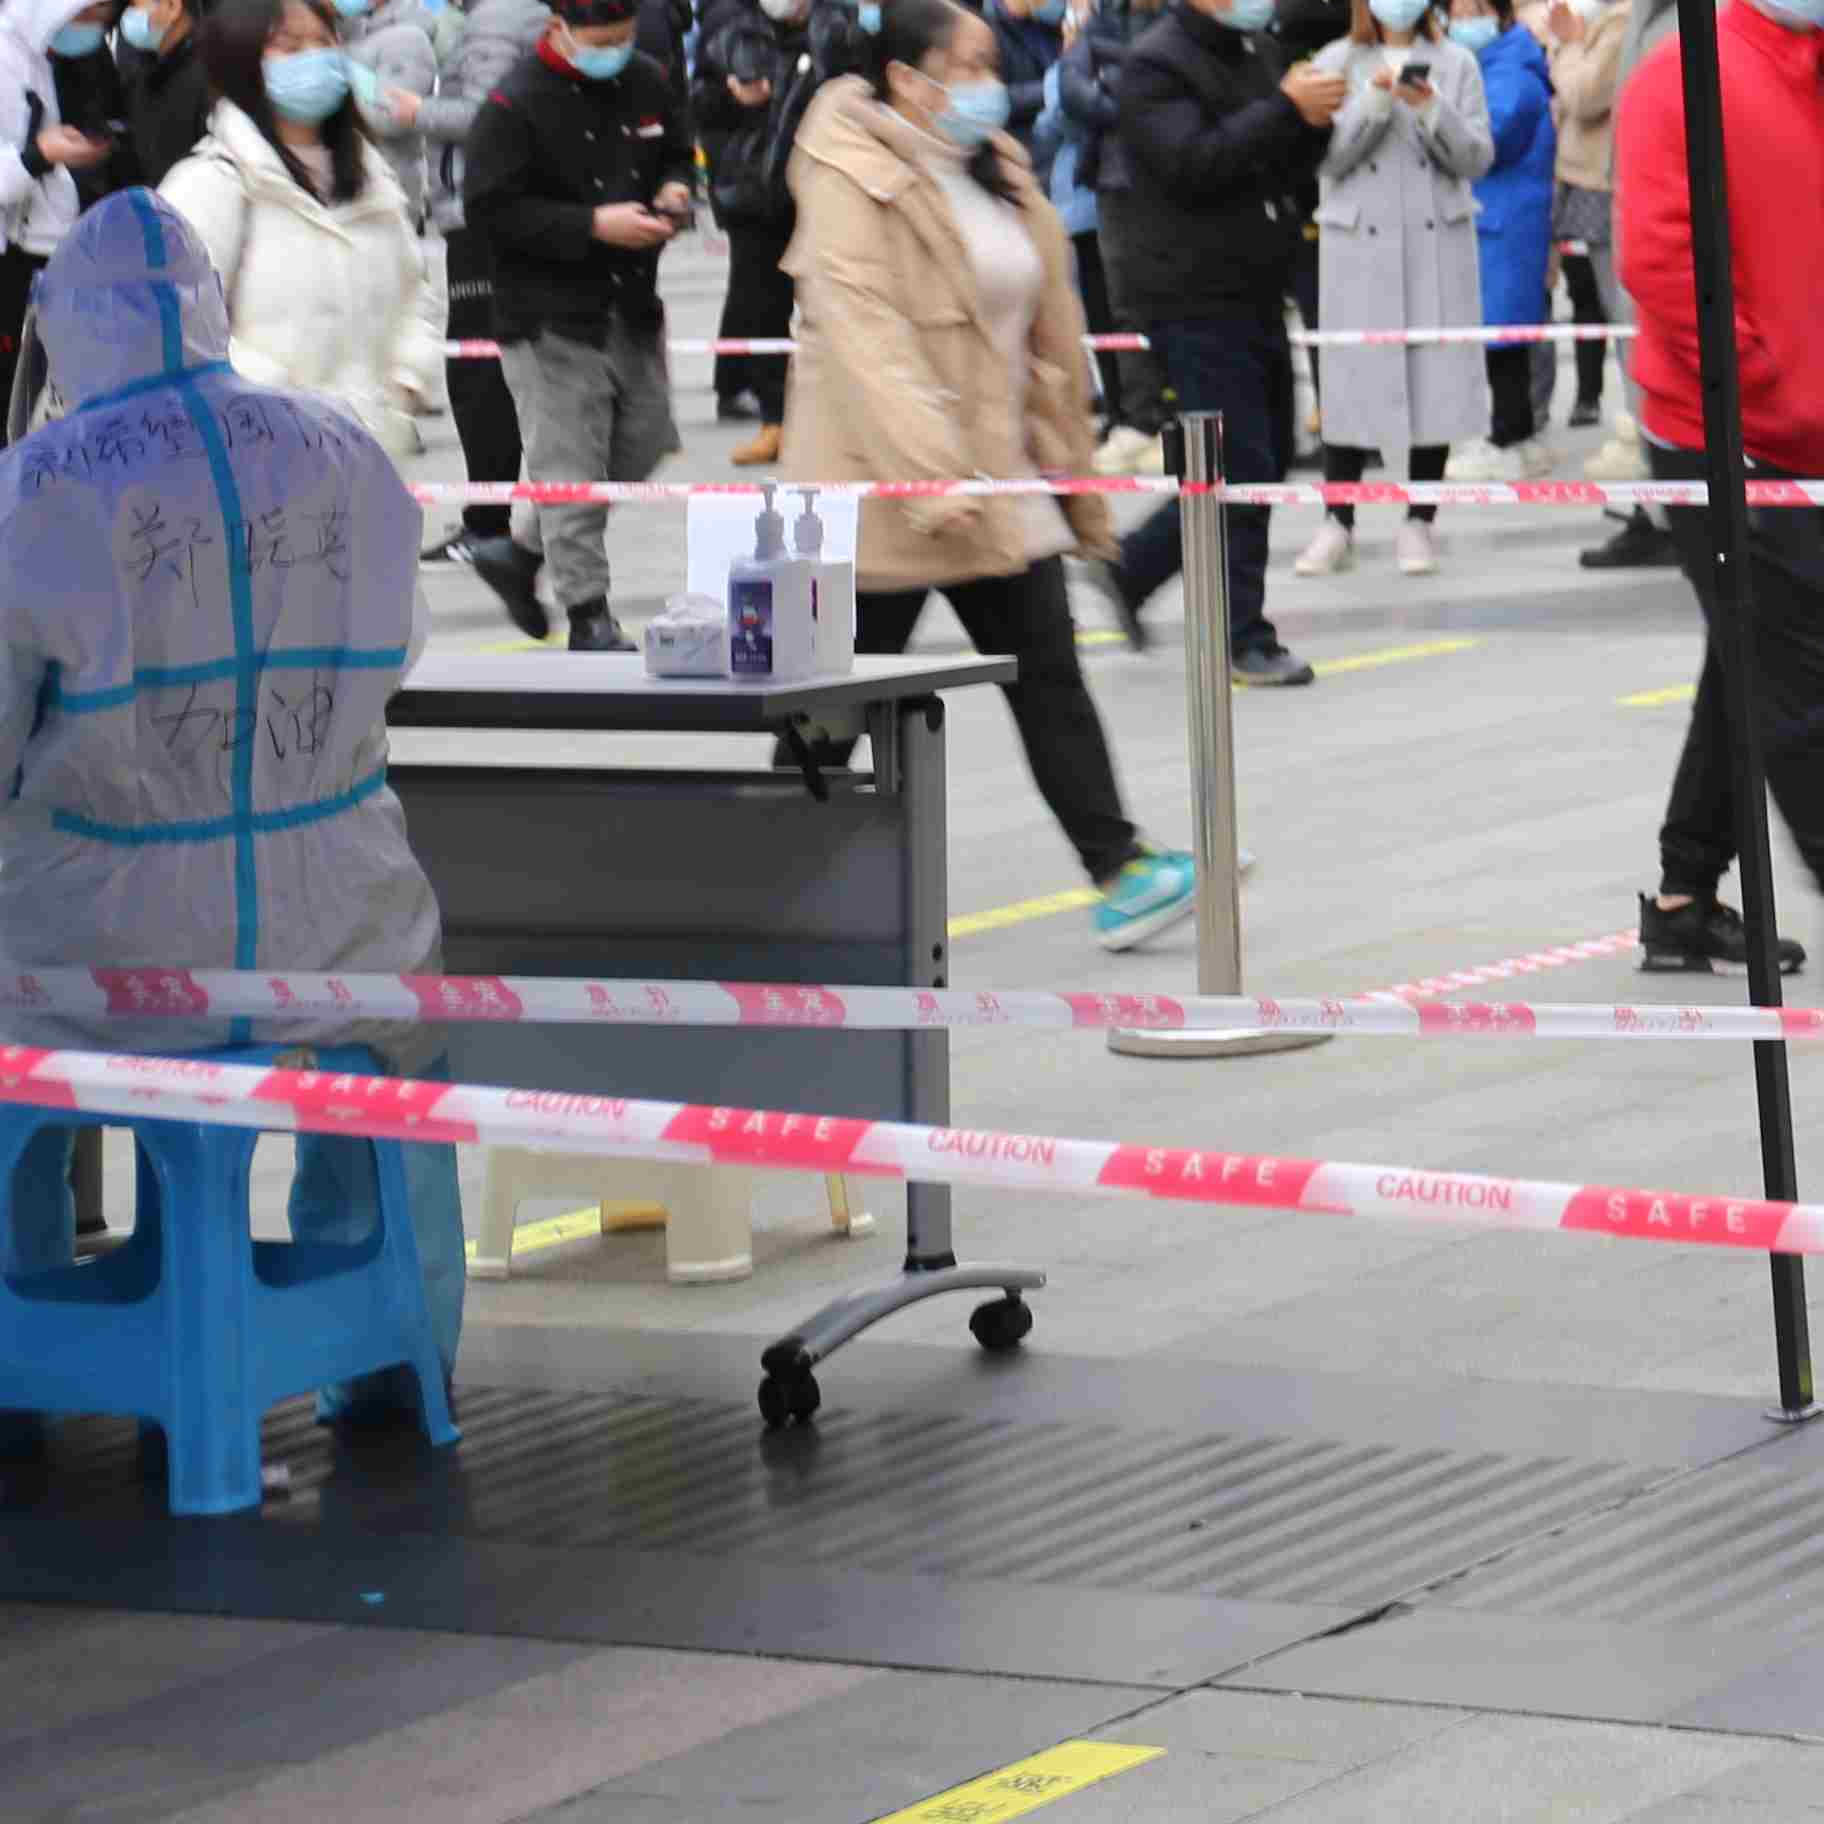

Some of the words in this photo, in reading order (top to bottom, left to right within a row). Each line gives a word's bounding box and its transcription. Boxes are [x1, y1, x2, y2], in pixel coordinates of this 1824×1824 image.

[296, 1074, 416, 1101] SAFE
[707, 1105, 841, 1142] SAFE
[927, 1127, 1056, 1167] CAUTION
[1145, 1147, 1278, 1186] SAFE
[1375, 1174, 1512, 1211] CAUTION
[1607, 1195, 1746, 1234] SAFE
